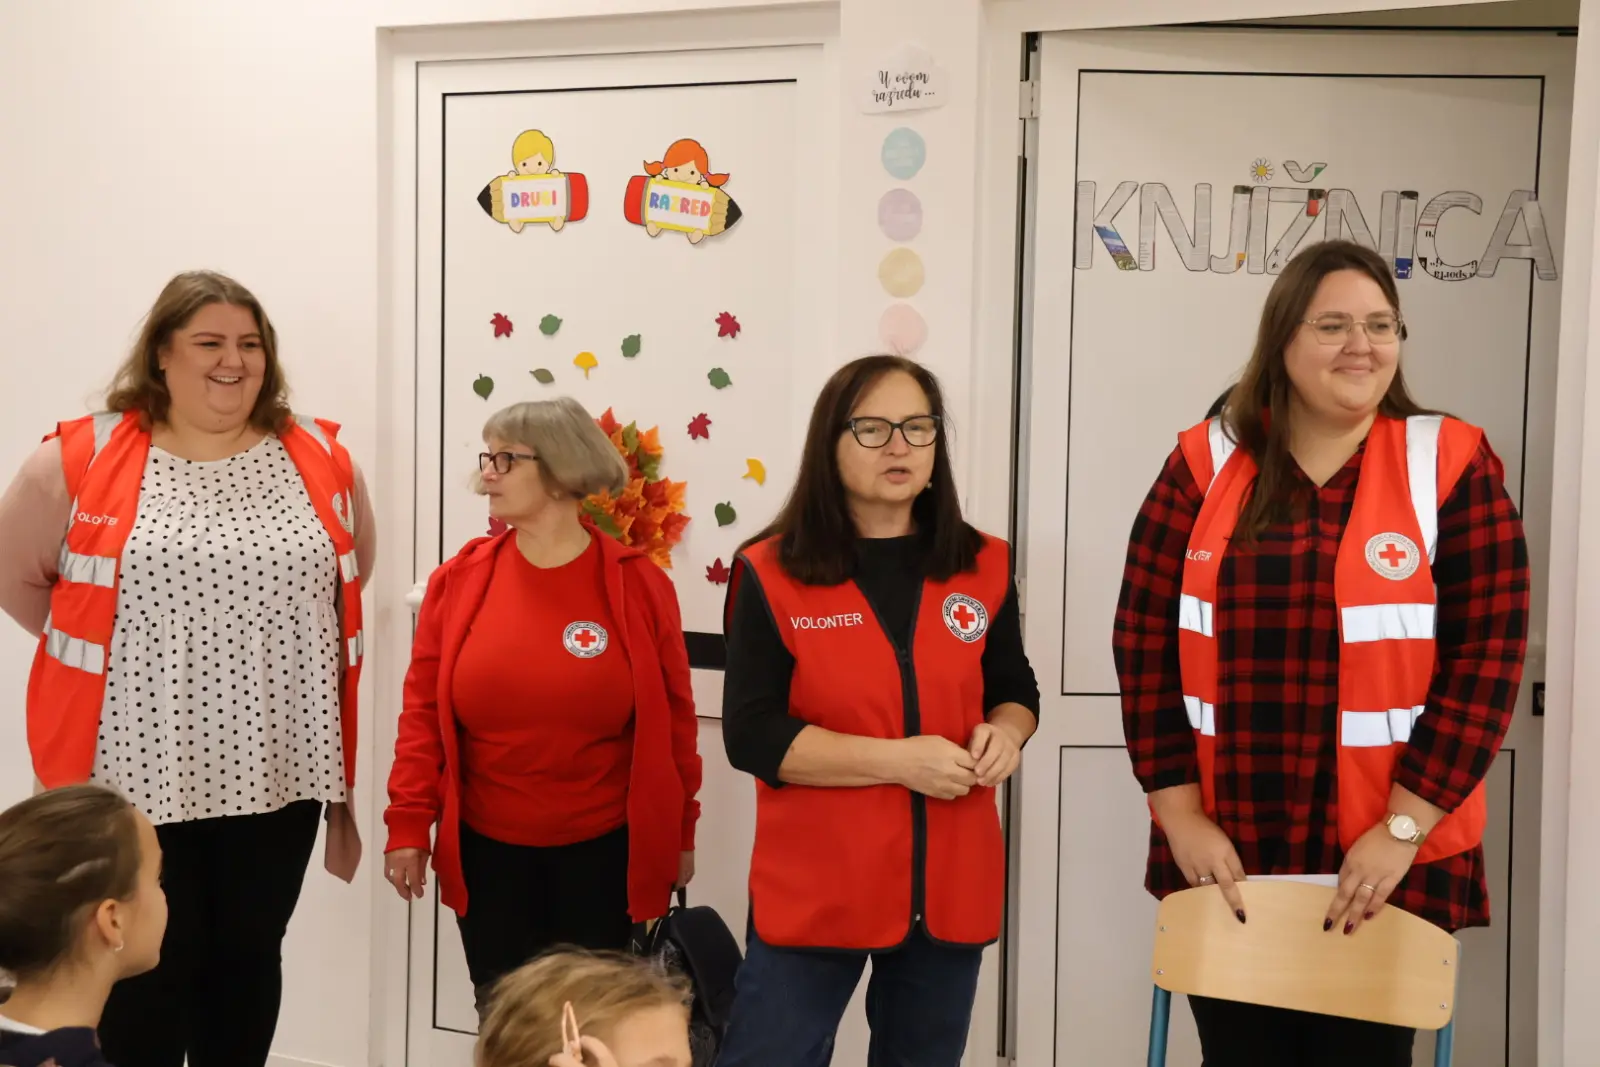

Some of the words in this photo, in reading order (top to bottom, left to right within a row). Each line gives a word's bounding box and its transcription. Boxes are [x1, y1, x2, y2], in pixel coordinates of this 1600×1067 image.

[510, 189, 557, 208] DRUGI
[649, 192, 711, 217] RAZRED
[790, 612, 864, 630] VOLONTER
